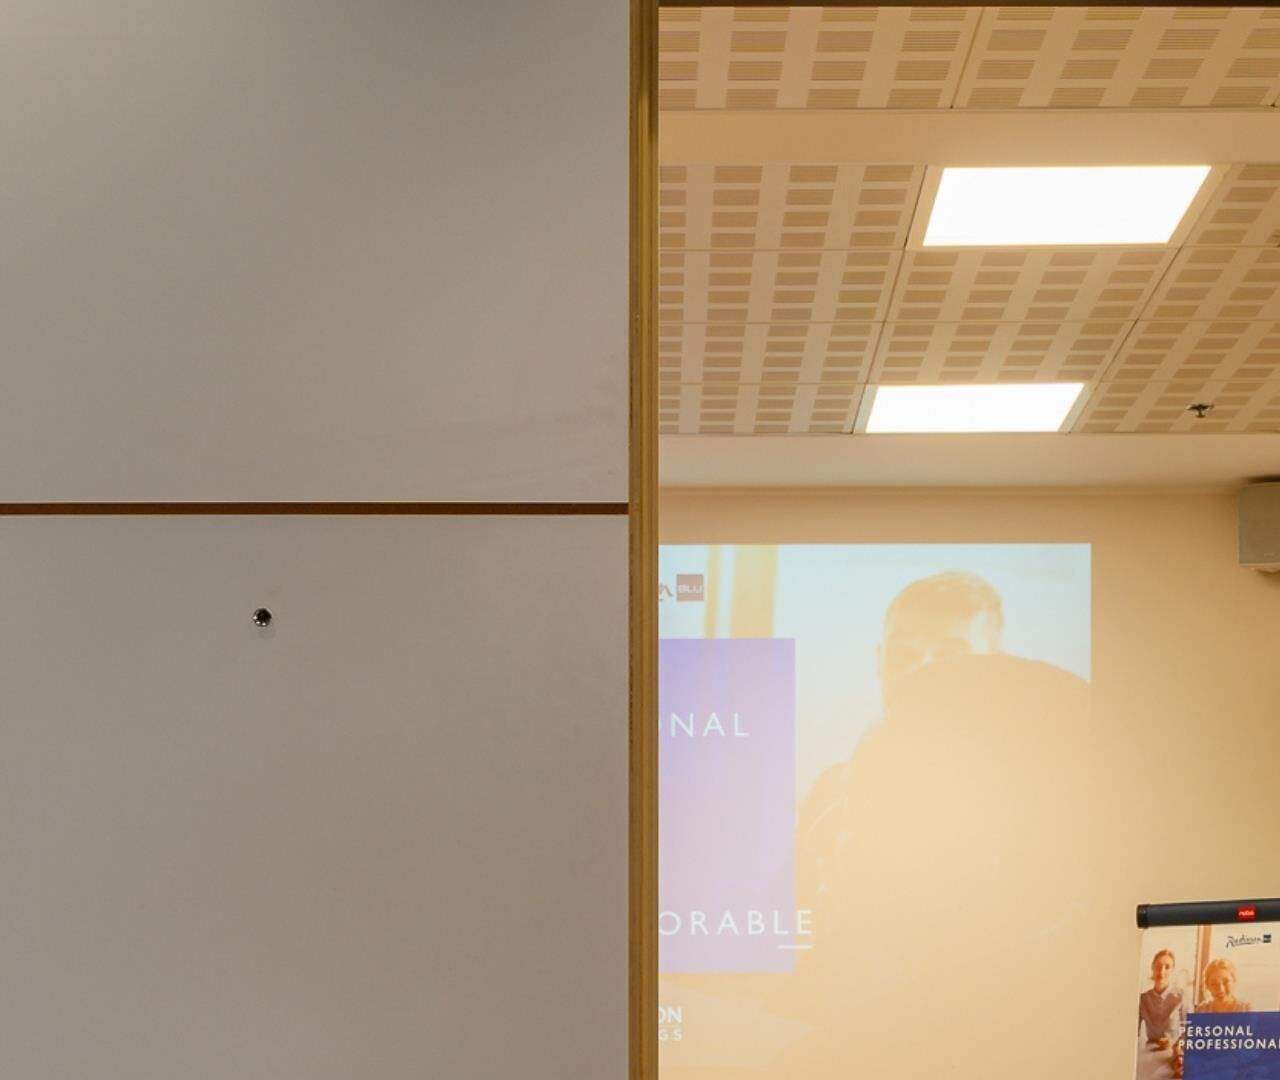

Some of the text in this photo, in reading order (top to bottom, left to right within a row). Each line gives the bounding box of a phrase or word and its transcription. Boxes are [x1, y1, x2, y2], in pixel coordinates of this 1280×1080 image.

[658, 712, 750, 737] NAL
[658, 910, 812, 936] ORABLE
[1179, 1025, 1254, 1037] PERSONAL
